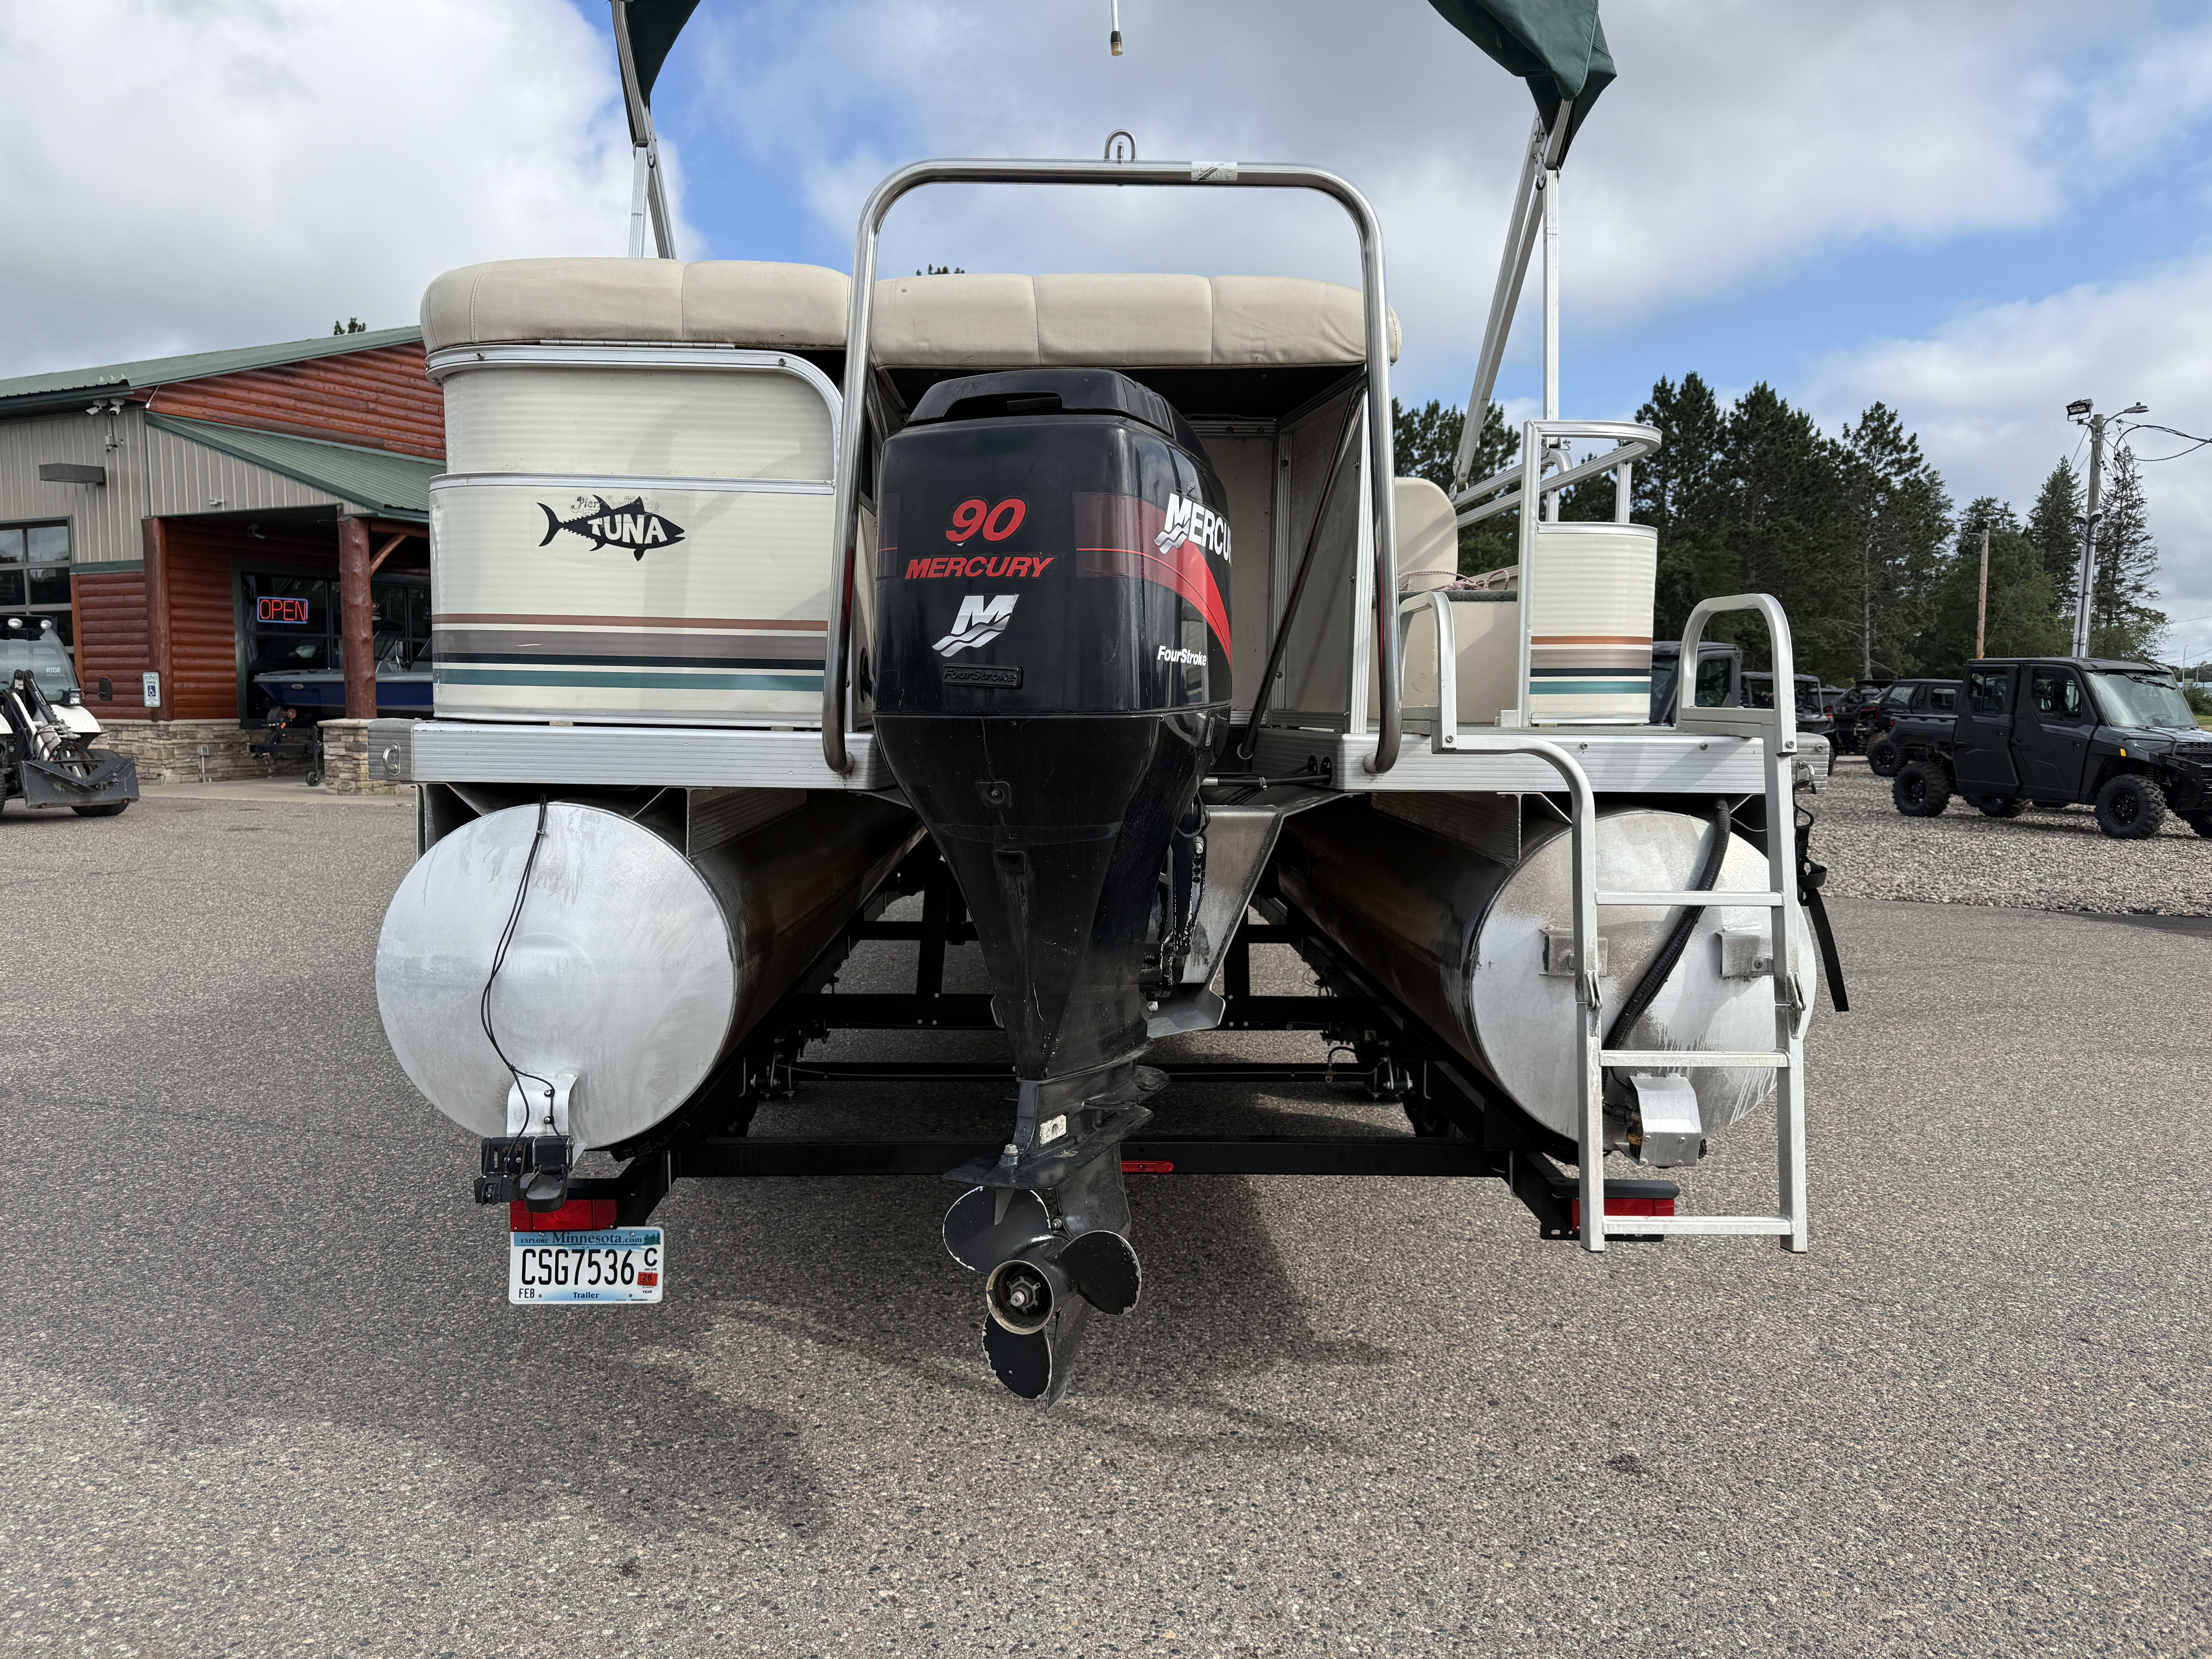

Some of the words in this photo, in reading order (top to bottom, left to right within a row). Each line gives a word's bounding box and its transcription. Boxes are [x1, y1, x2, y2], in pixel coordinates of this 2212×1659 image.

[587, 514, 668, 544] TUNA
[946, 498, 1026, 541] 90
[905, 556, 1054, 579] MERCURY
[260, 599, 306, 622] OPEN
[1157, 645, 1207, 666] FourStroke
[943, 669, 1017, 682] FourStroke
[522, 1249, 635, 1285] CSG7536
[644, 1247, 658, 1267] C
[519, 1288, 534, 1298] FEB
